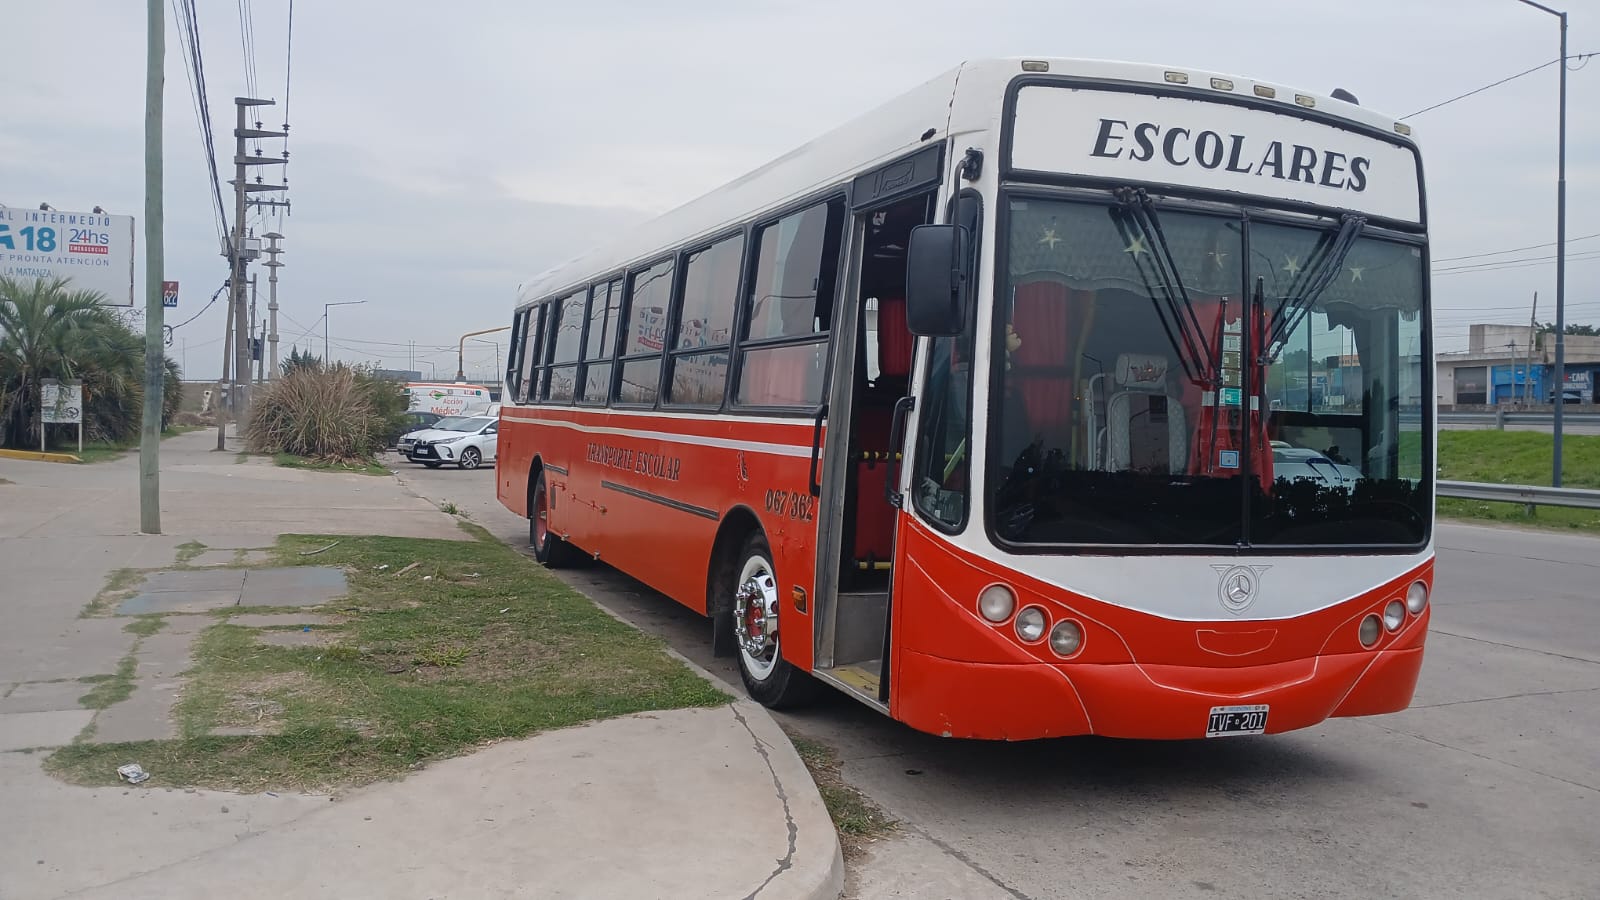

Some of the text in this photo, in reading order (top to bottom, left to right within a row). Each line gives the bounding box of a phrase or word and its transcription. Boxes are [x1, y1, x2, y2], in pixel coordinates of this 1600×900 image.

[1089, 118, 1370, 192] ESCOLARES
[25, 212, 110, 226] INTERMEDIO
[19, 226, 56, 252] 18
[69, 228, 109, 245] 24hs
[9, 254, 53, 263] PRONTA
[586, 443, 681, 481] TRANSPORTE ESCOLAR
[765, 488, 814, 522] 067/362
[1209, 712, 1264, 732] IVF 201
